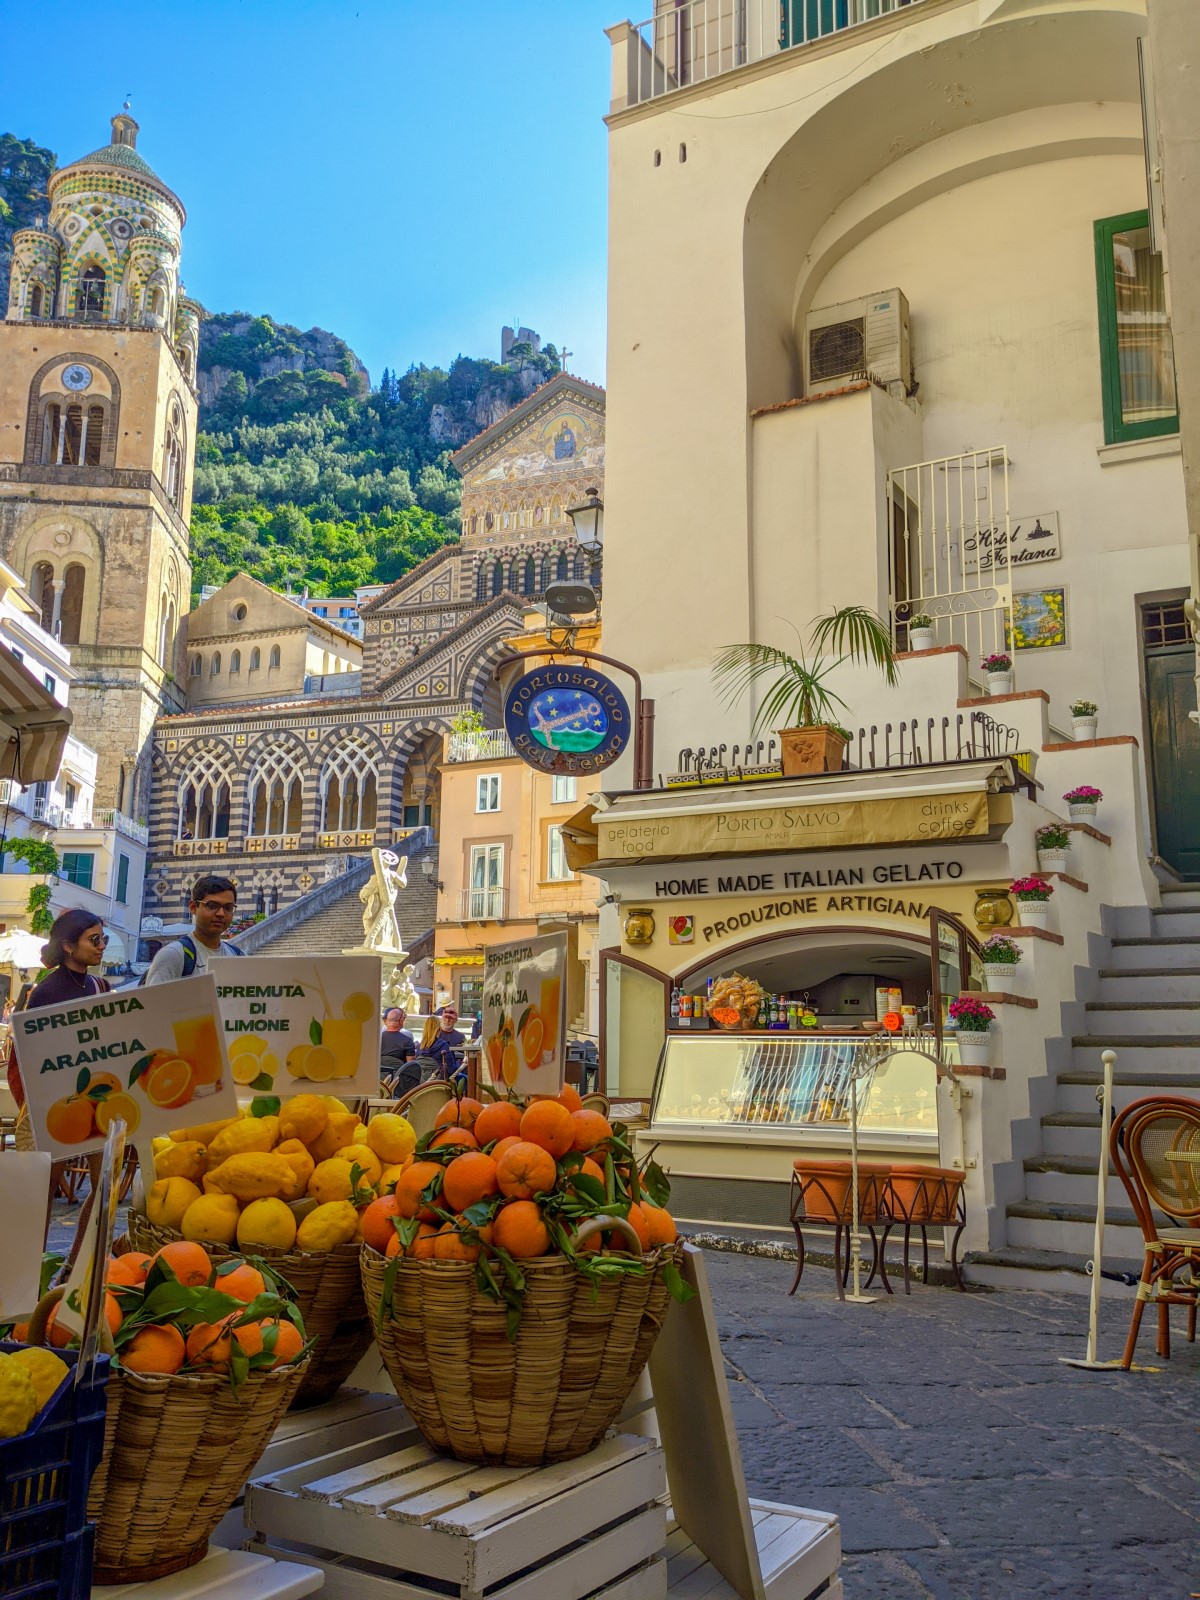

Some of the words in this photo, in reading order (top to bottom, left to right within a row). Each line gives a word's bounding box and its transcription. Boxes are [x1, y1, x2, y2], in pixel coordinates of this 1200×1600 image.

[964, 525, 1021, 551] Hotel
[979, 546, 1057, 569] Fontana
[921, 800, 969, 817] drinks
[608, 825, 670, 842] gelateria
[918, 817, 976, 834] coffee
[622, 838, 654, 853] food
[655, 878, 709, 897] HOME
[717, 873, 774, 893] MADE
[784, 868, 864, 889] ITALIAN
[873, 861, 963, 884] GELATO
[702, 897, 818, 942] PRODUZIONE
[488, 947, 533, 968] SPREMUTA
[216, 985, 305, 998] SPREMUTA
[23, 997, 145, 1035] SPREMUTA
[249, 1002, 266, 1015] DI
[225, 1019, 290, 1032] LIMONE
[76, 1026, 100, 1045] DI
[39, 1038, 147, 1075] ARANCIA
